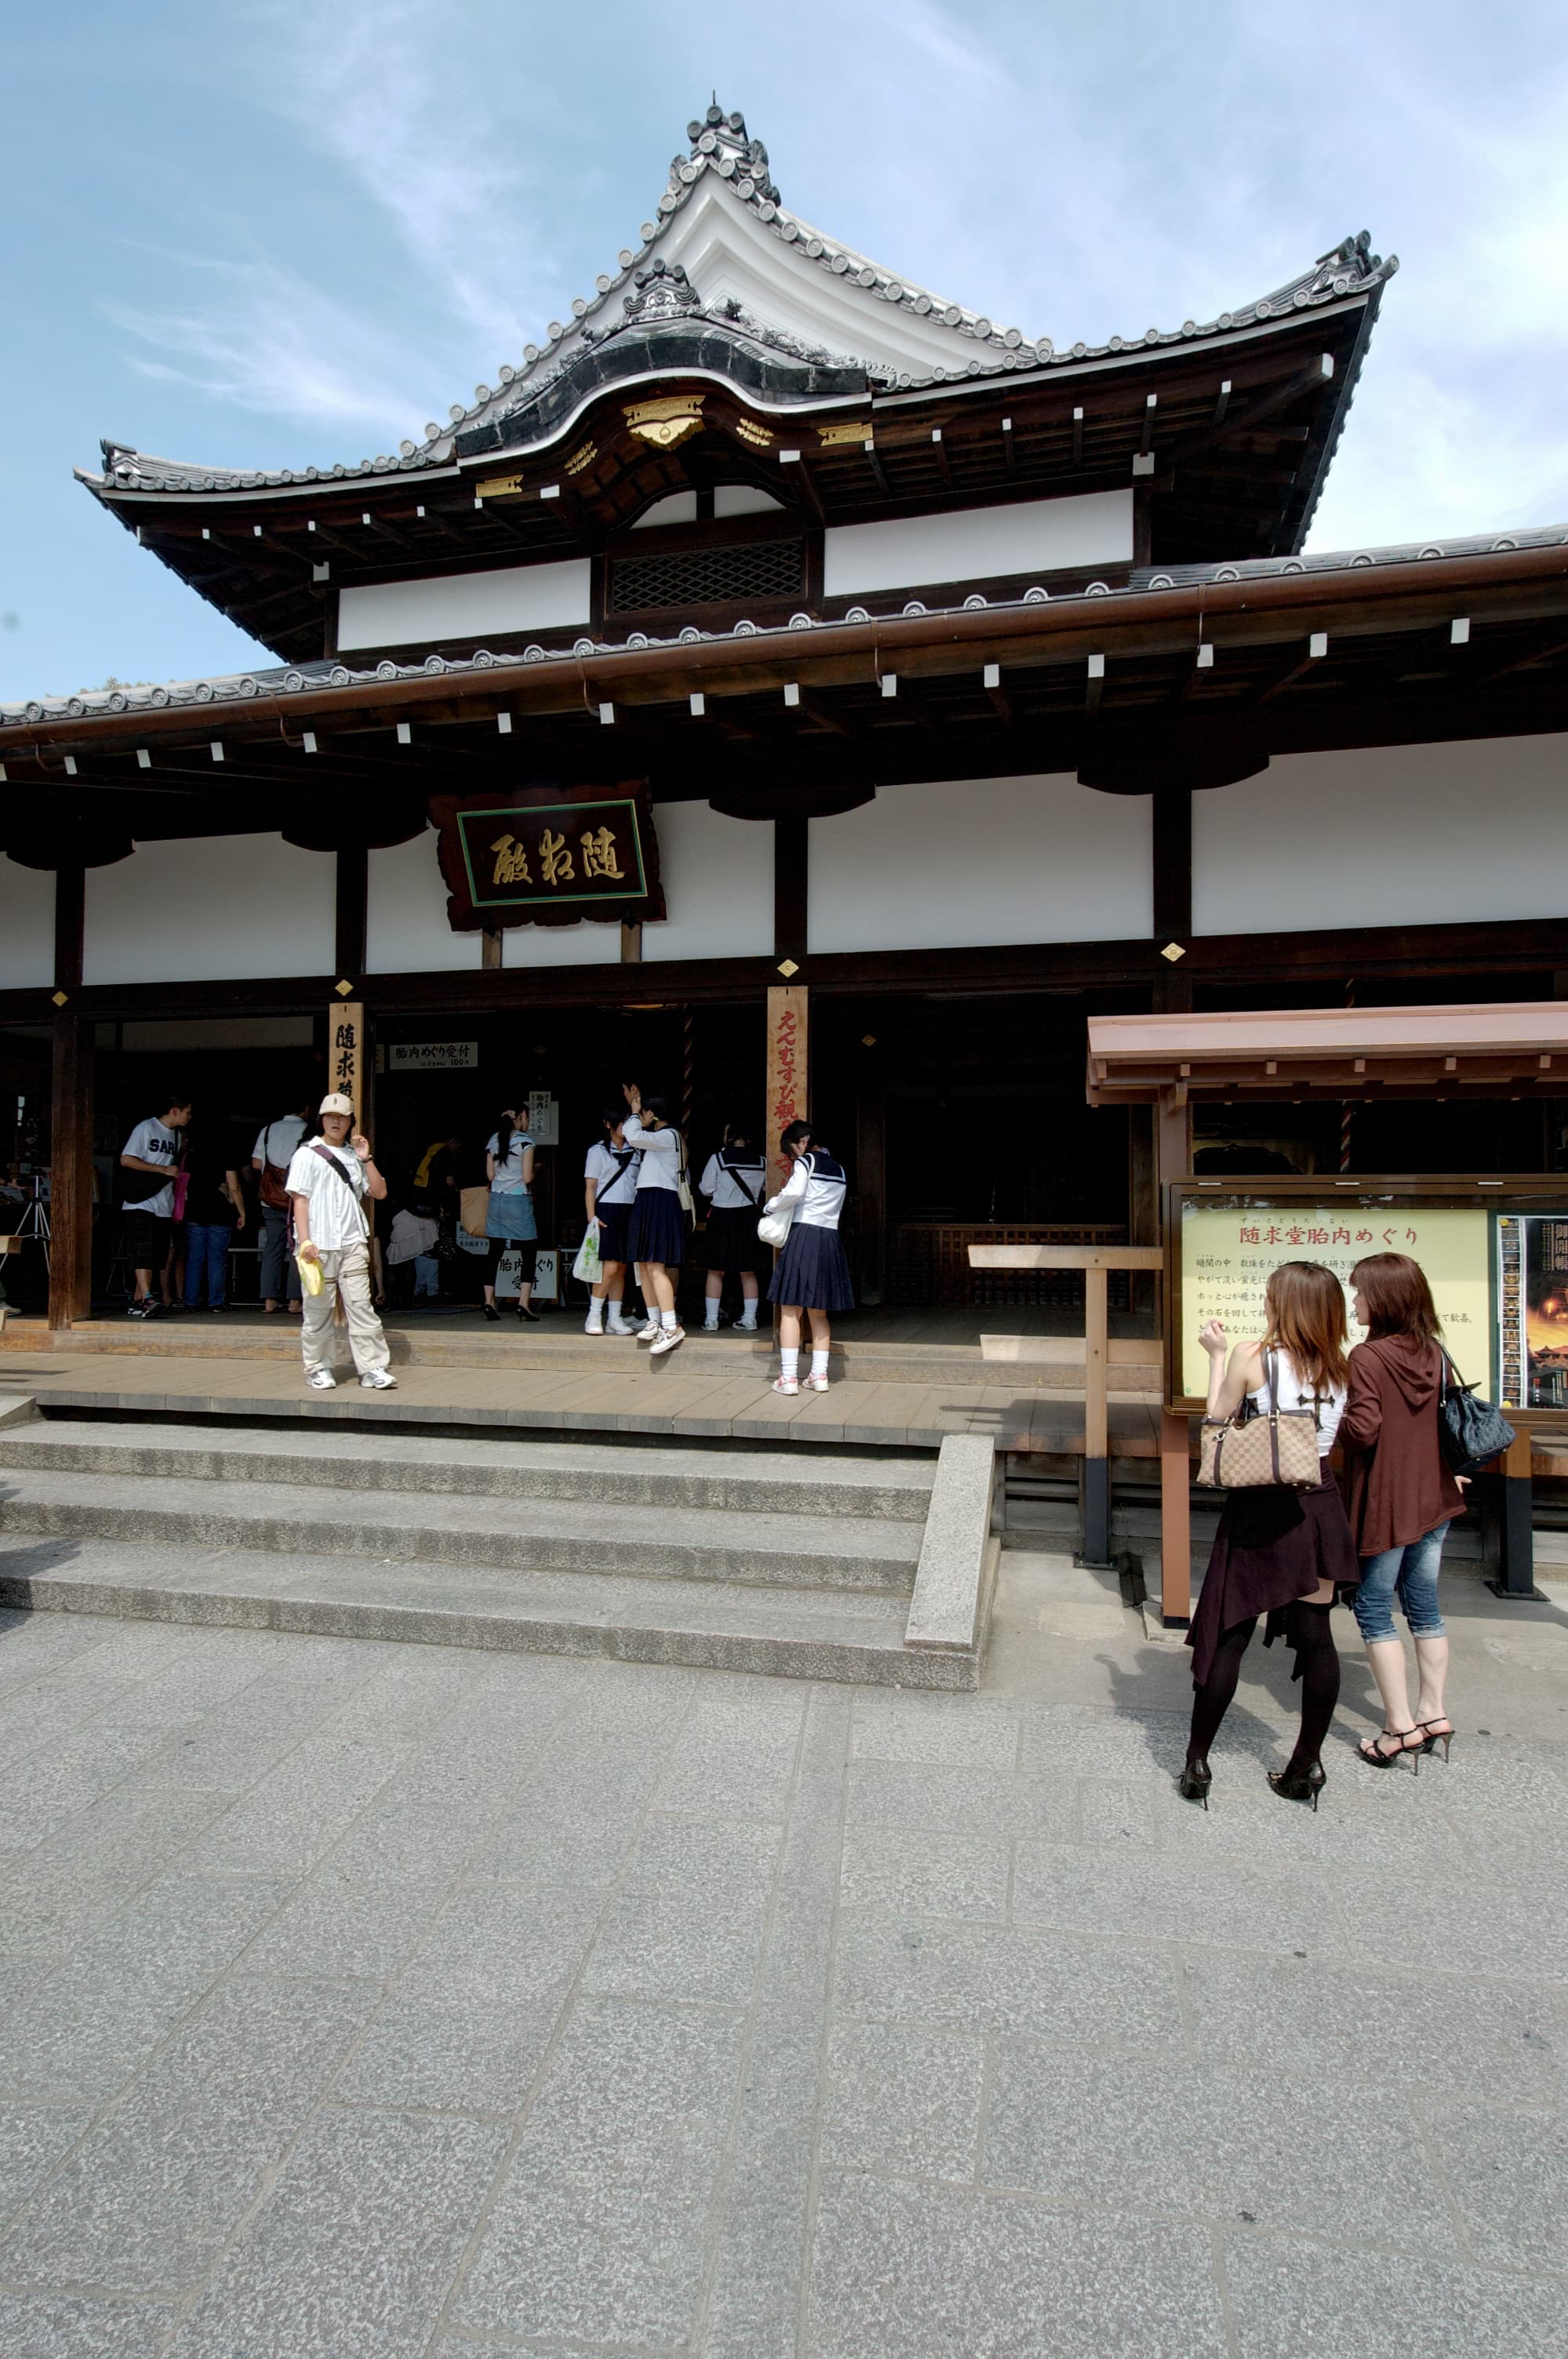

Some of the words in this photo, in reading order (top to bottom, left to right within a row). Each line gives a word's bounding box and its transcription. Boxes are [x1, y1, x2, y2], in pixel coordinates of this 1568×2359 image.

[395, 1045, 470, 1059] 胎内めぐり受付
[1240, 1226, 1417, 1245] 随求堂胎内めぐり
[499, 1258, 554, 1273] 胎内ぐり
[1196, 1258, 1231, 1268] 暗闇の中
